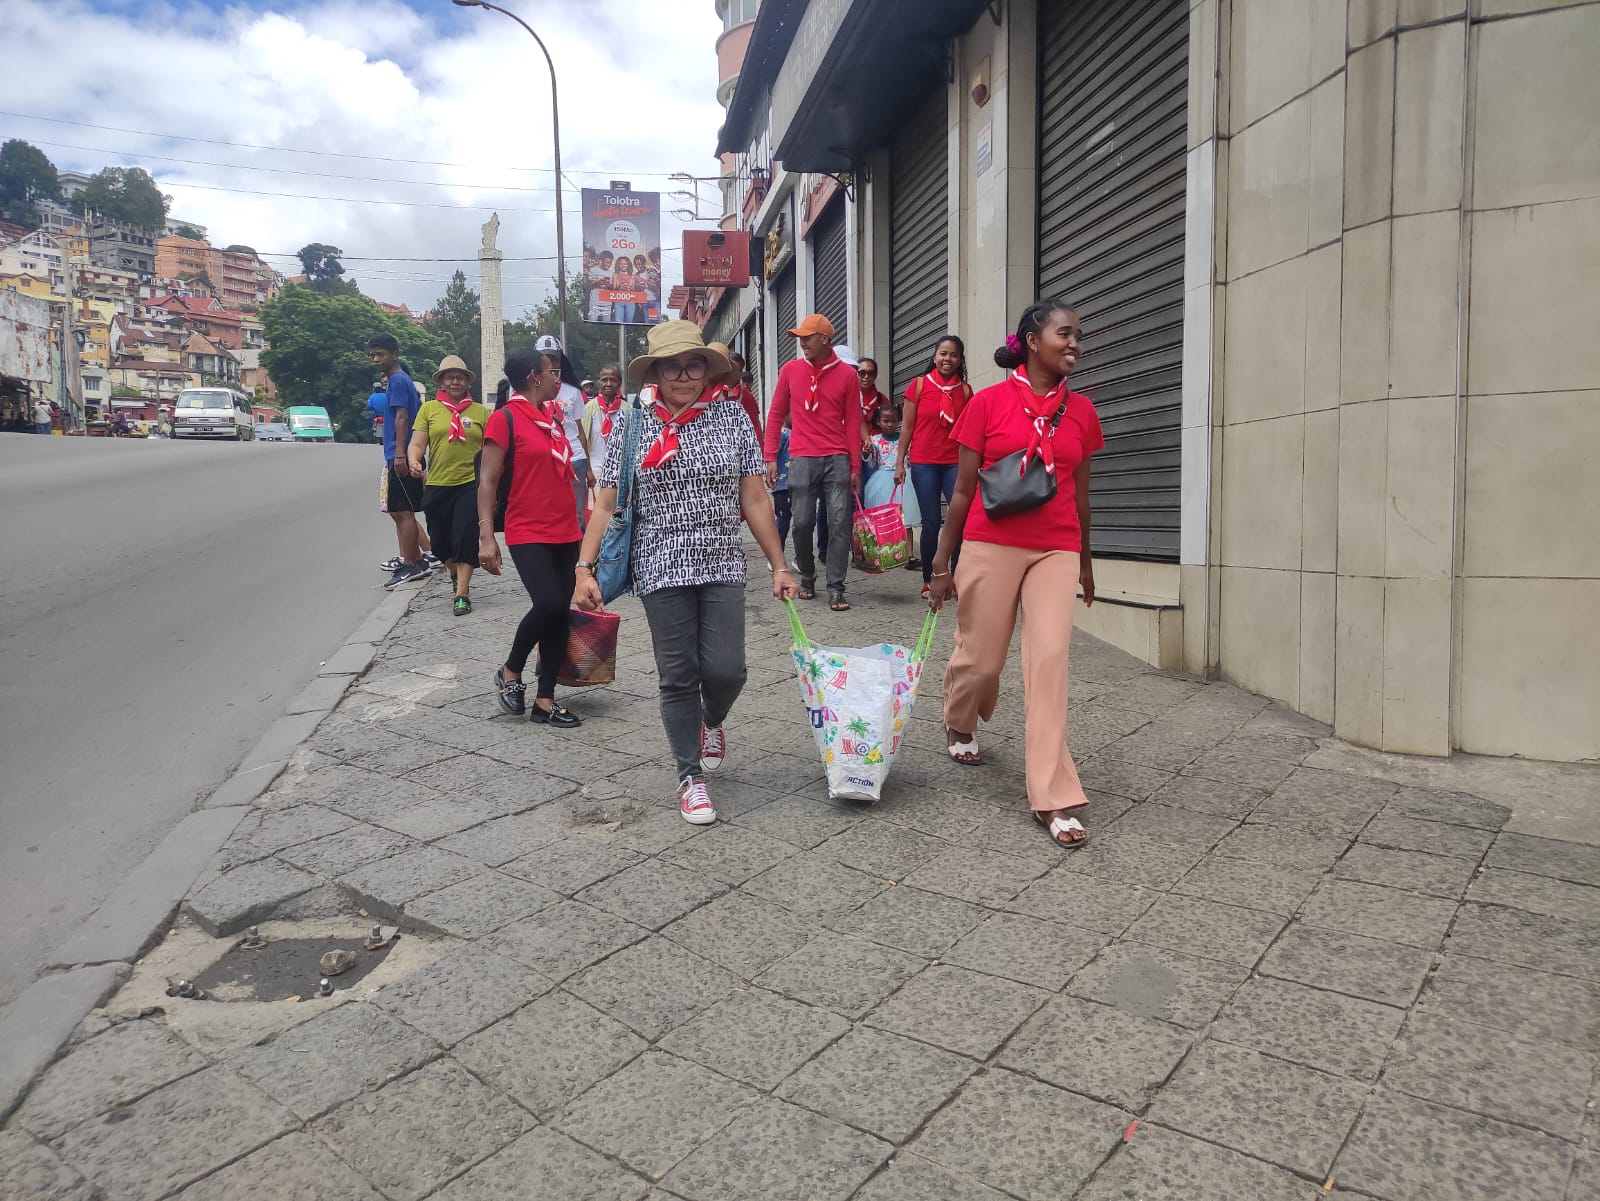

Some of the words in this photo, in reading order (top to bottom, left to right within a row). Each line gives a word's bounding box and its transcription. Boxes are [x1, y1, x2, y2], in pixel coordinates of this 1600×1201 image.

[603, 195, 640, 206] Tolotra
[611, 238, 636, 250] 2Go
[702, 268, 732, 277] money
[847, 776, 874, 788] ACTION
